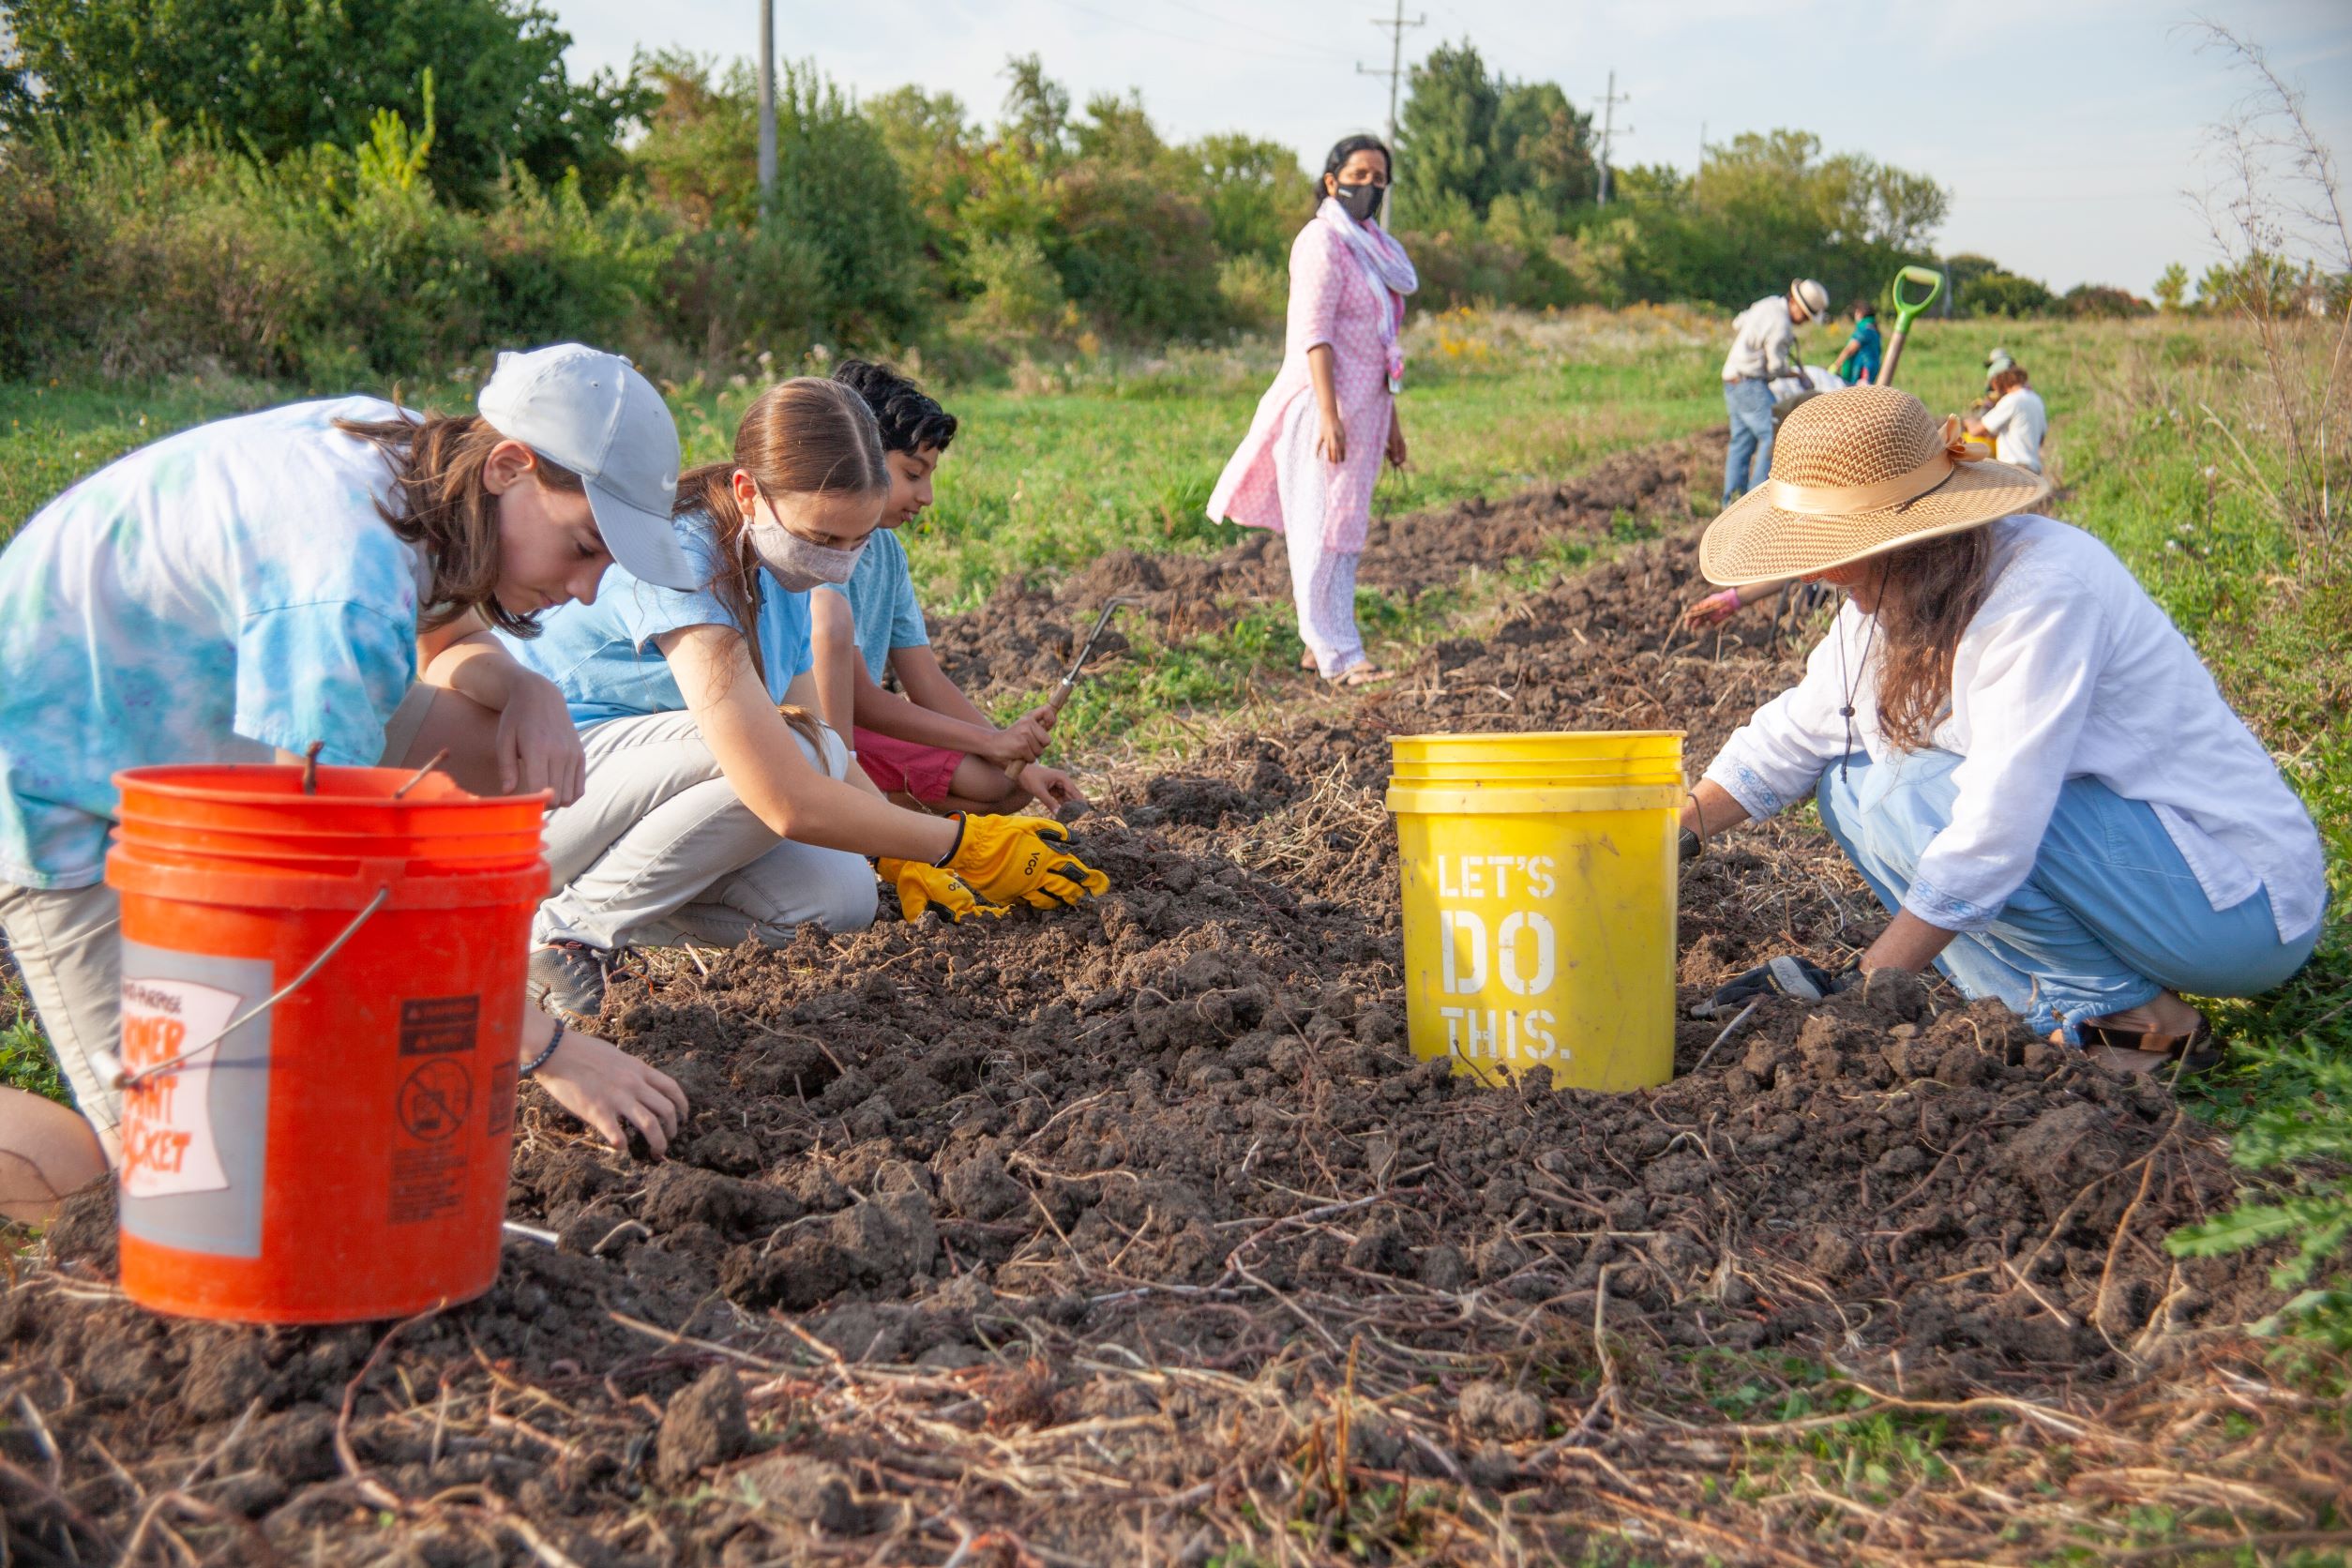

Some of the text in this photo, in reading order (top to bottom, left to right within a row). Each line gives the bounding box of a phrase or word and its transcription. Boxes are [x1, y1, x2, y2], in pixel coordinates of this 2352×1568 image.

[1438, 854, 1556, 898] LET'S
[1440, 910, 1556, 995] DO
[1440, 1006, 1572, 1059] THIS.
